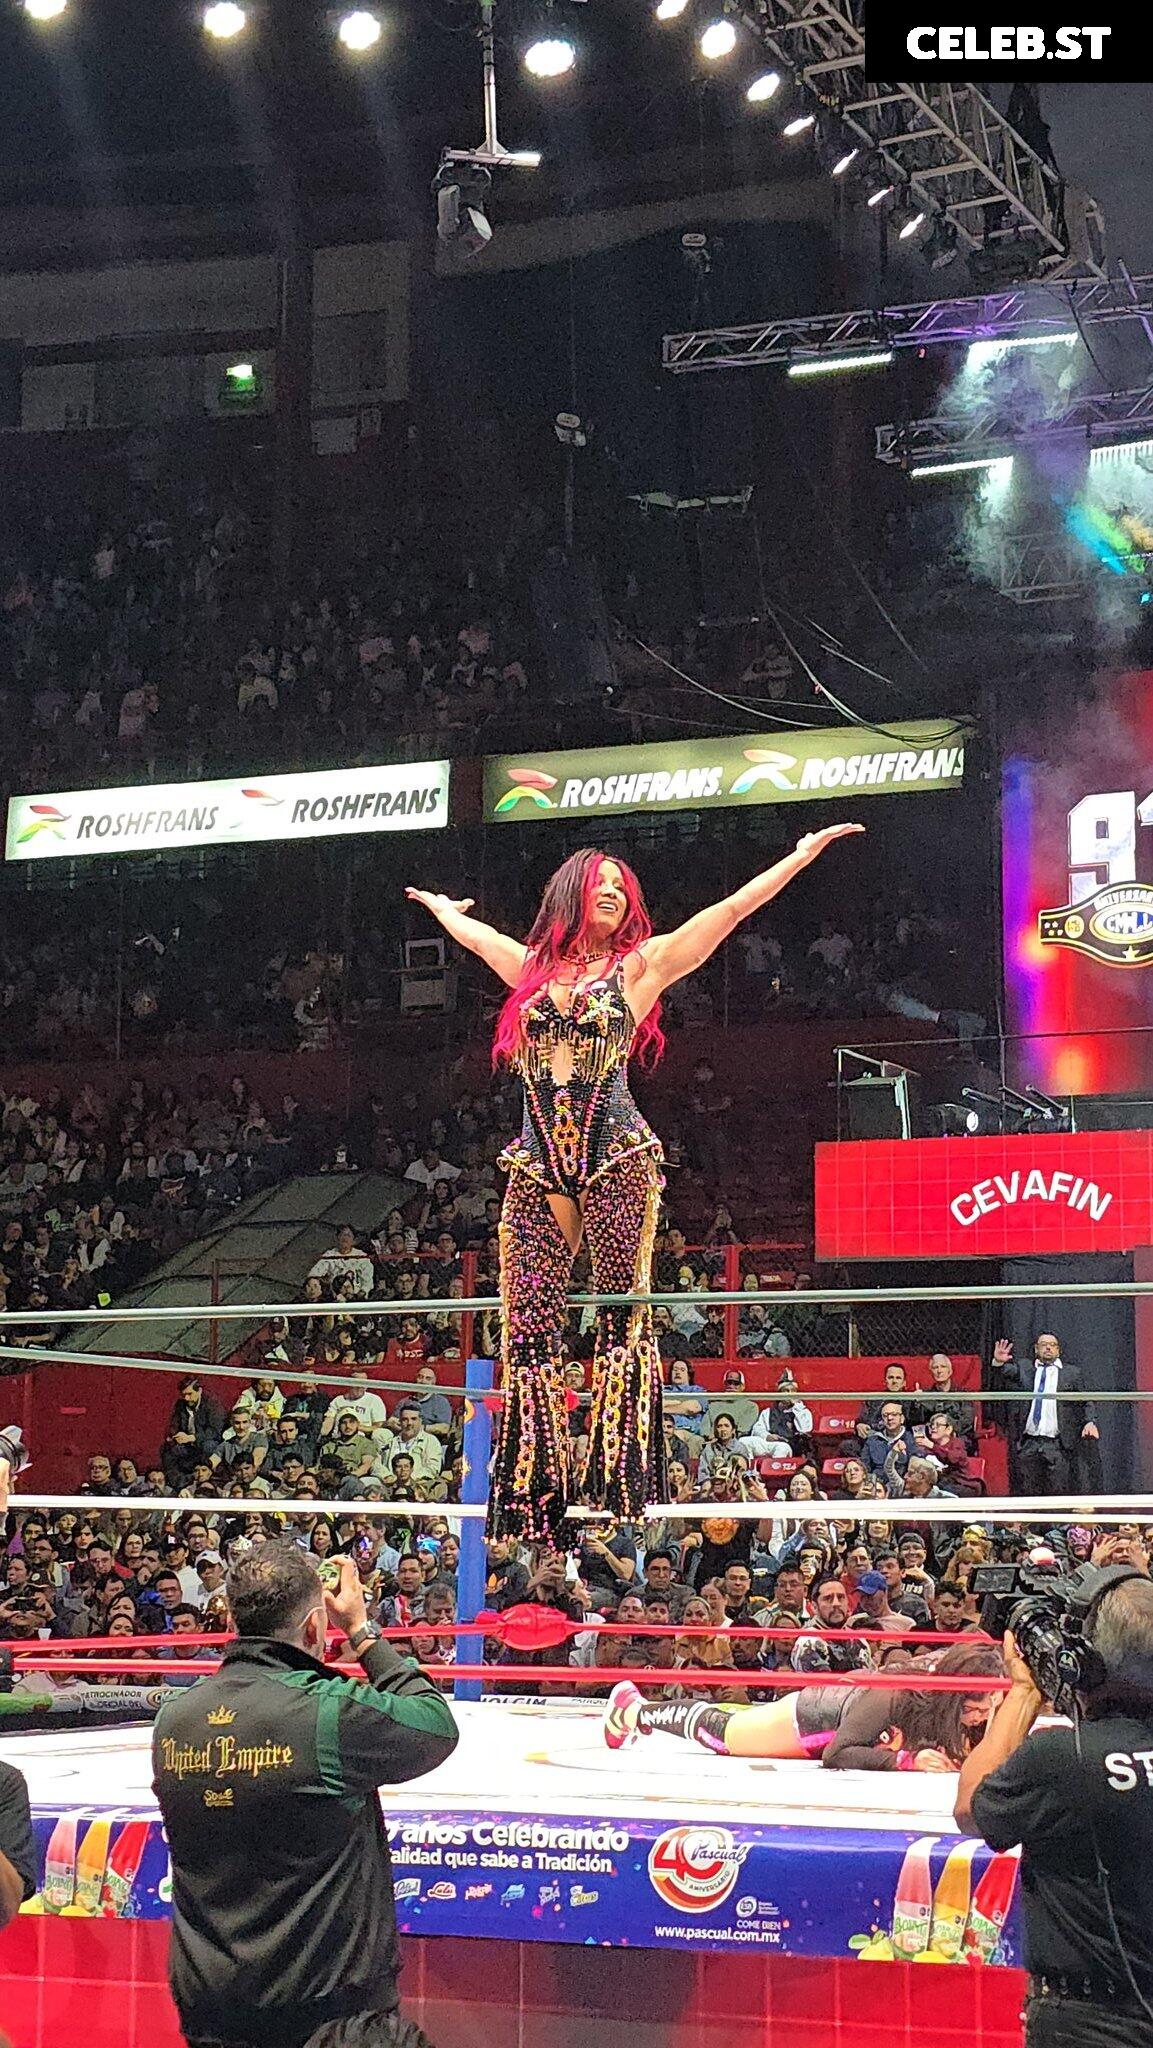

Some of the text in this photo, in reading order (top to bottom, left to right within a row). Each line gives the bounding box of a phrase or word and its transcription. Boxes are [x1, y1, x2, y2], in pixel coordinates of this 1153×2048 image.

[291, 788, 441, 824] ROSHFRANS
[76, 806, 219, 840] ROSHFRANS
[950, 1169, 1112, 1226] CEVAFIN
[161, 1735, 294, 1780] United Empire
[472, 1821, 630, 1851] Celebrando
[691, 1840, 747, 1862] Pascual
[389, 1844, 612, 1873] alidad que sabe a Tradición
[689, 1871, 731, 1892] ANIVERSARIO
[655, 1925, 781, 1943] www.pascual.com.mx
